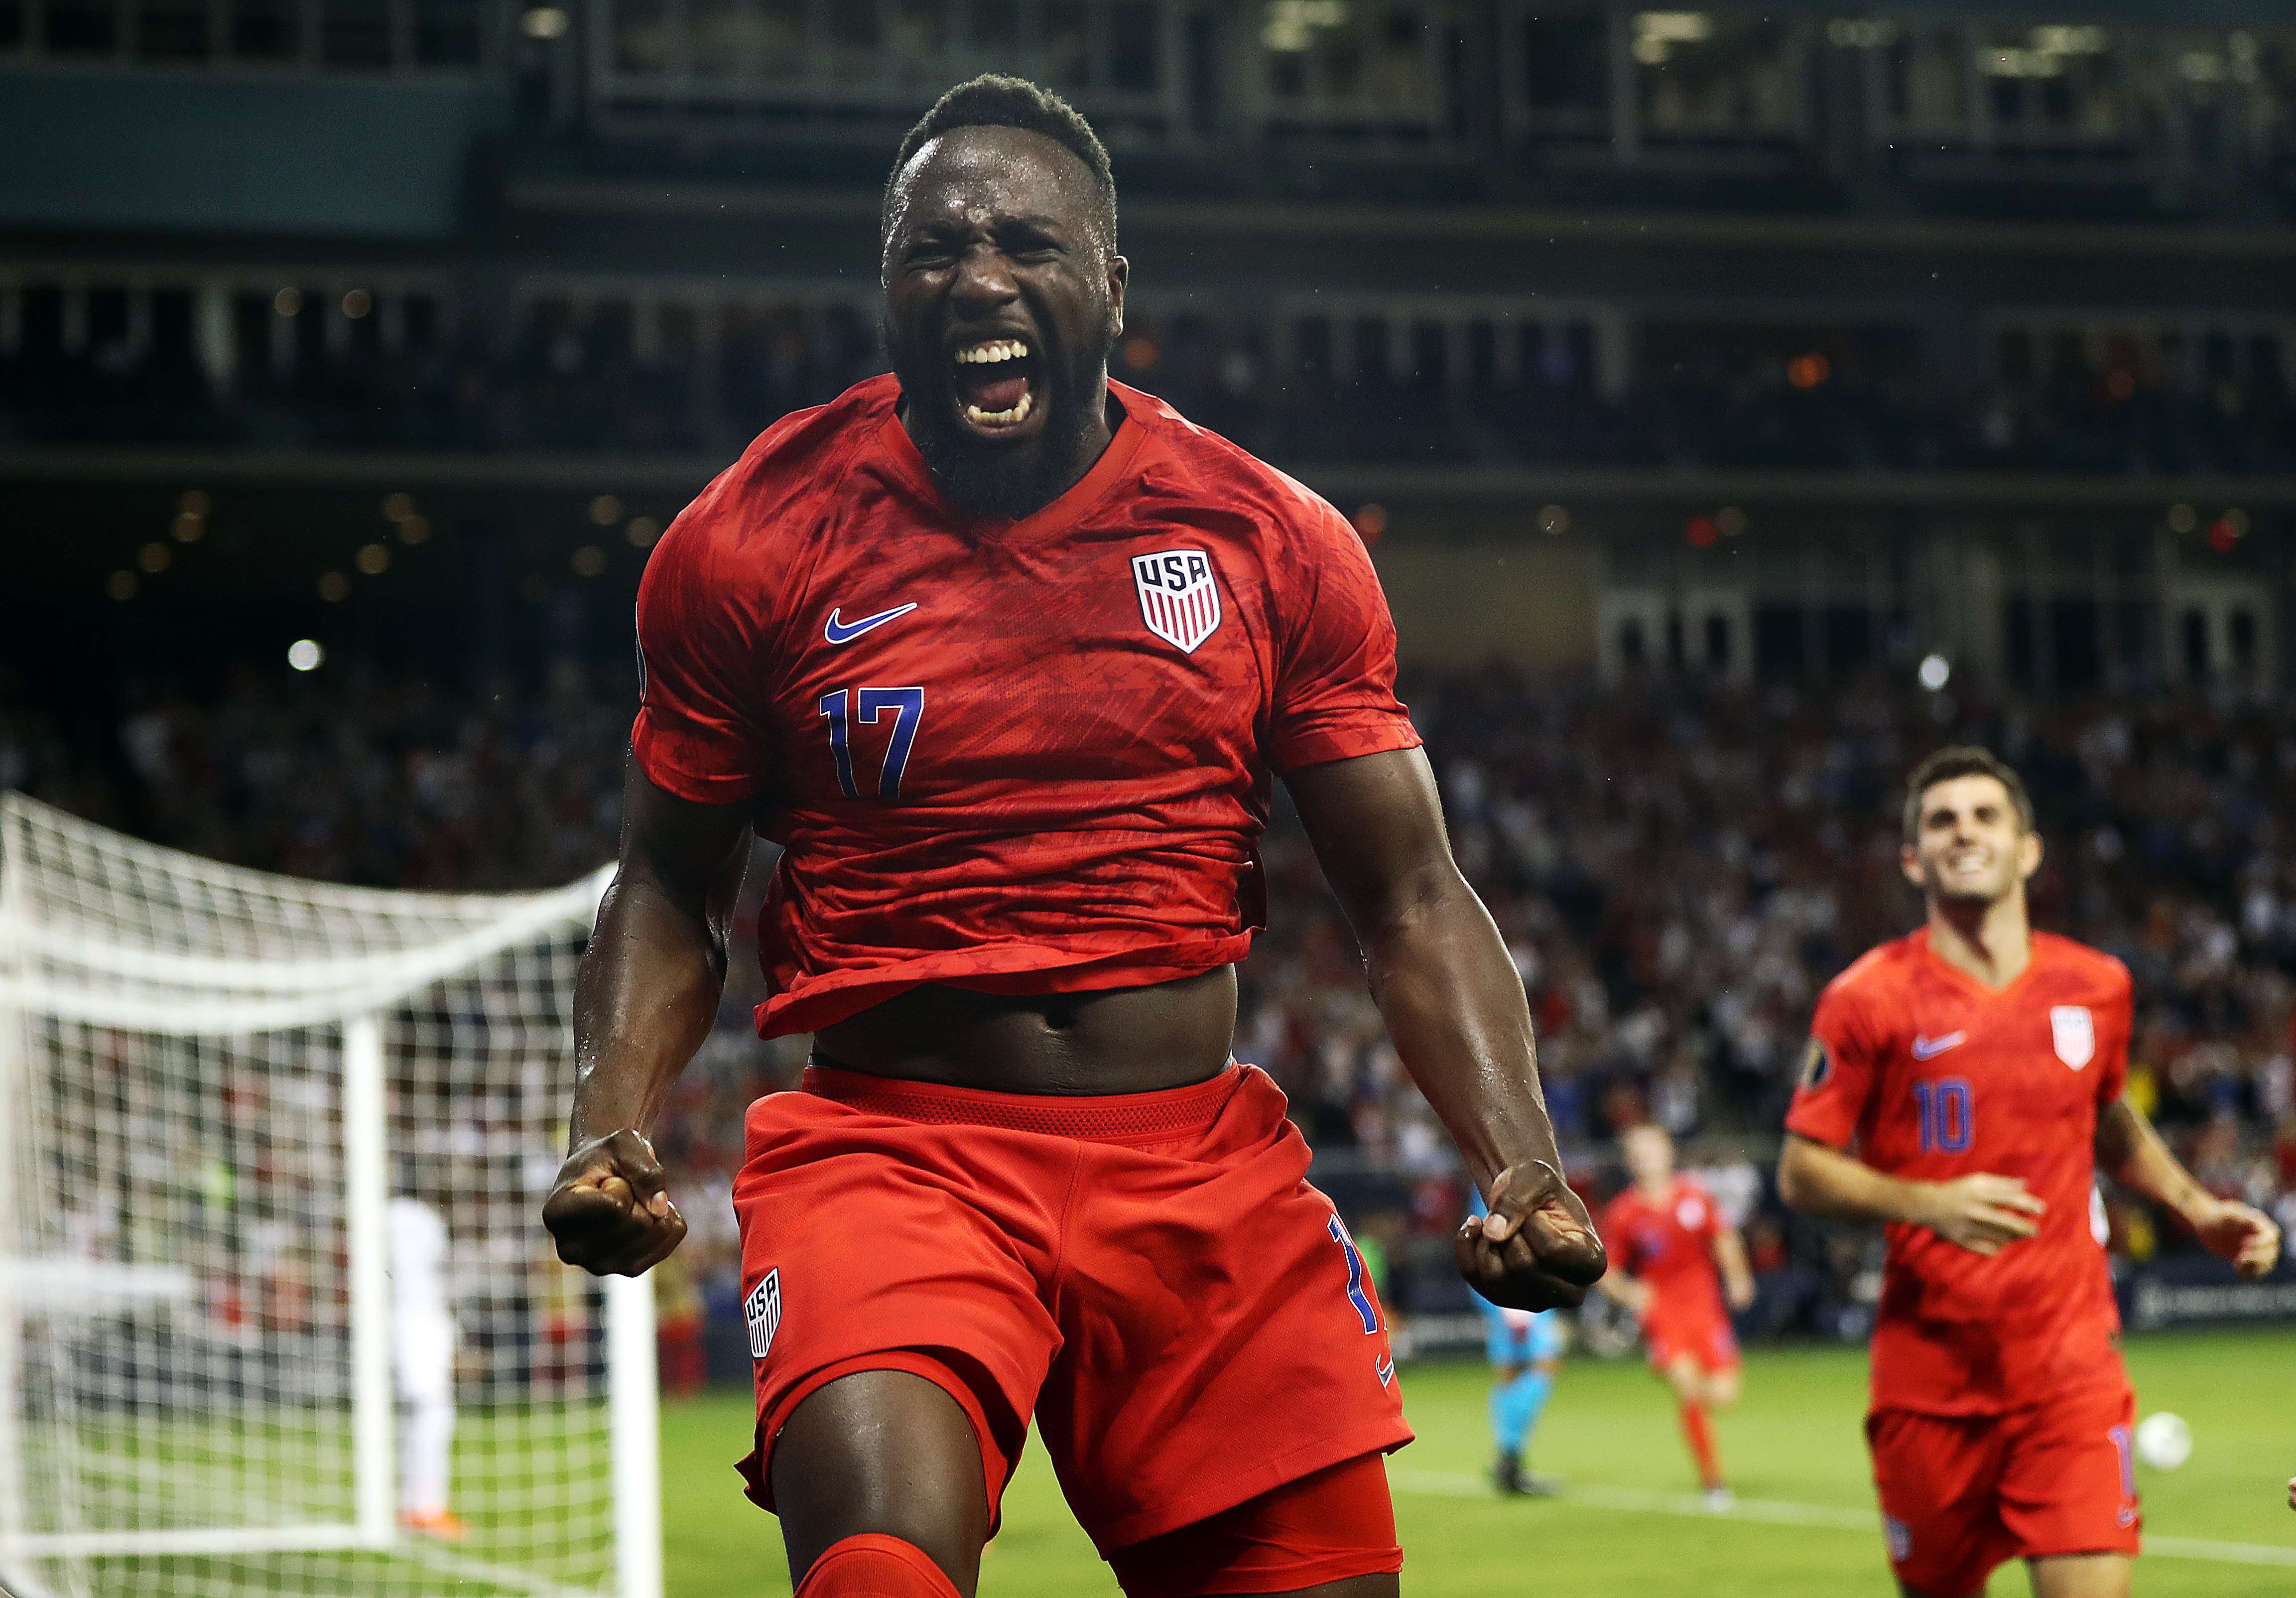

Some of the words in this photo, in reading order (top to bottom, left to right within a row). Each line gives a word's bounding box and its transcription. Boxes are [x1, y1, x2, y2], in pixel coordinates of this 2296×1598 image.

[1139, 556, 1206, 592] USA
[819, 686, 924, 799] 17
[1913, 1076, 1975, 1155] 10
[747, 1273, 776, 1322] USA
[1327, 1213, 1388, 1335] 1
